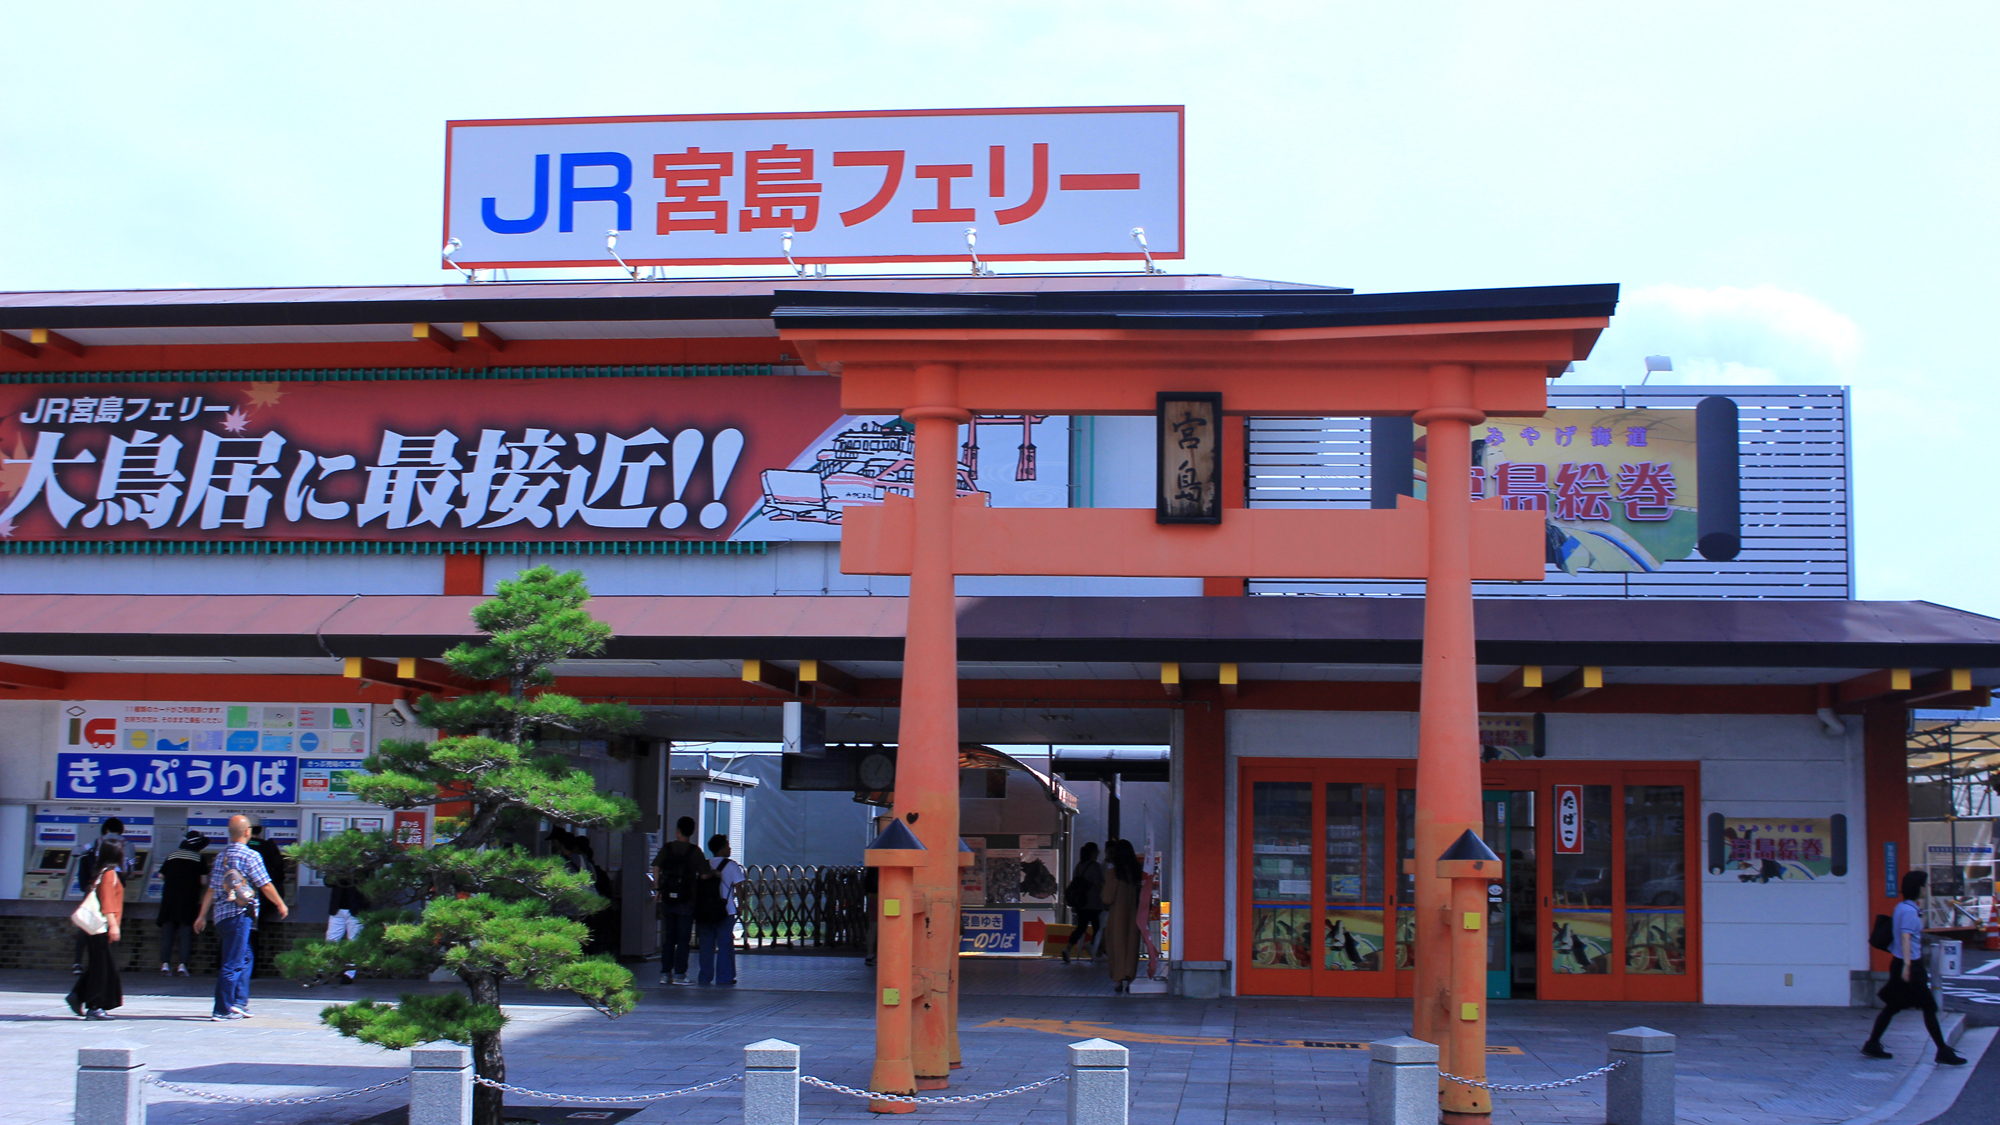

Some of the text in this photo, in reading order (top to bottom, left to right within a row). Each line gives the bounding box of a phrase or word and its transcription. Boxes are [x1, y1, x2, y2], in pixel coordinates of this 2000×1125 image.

[481, 142, 1141, 236] JR宮島フェリー
[19, 396, 231, 424] JR宮島フェリー
[1172, 411, 1207, 502] 宮島
[0, 427, 745, 530] 大鳥居に最接近!!
[67, 757, 287, 797] きっぷうりば
[1562, 796, 1578, 842] たばこ
[1730, 838, 1825, 861] 宮島絵巻
[960, 931, 1017, 949] ーのりば
[962, 914, 1003, 928] 宮島ゆき
